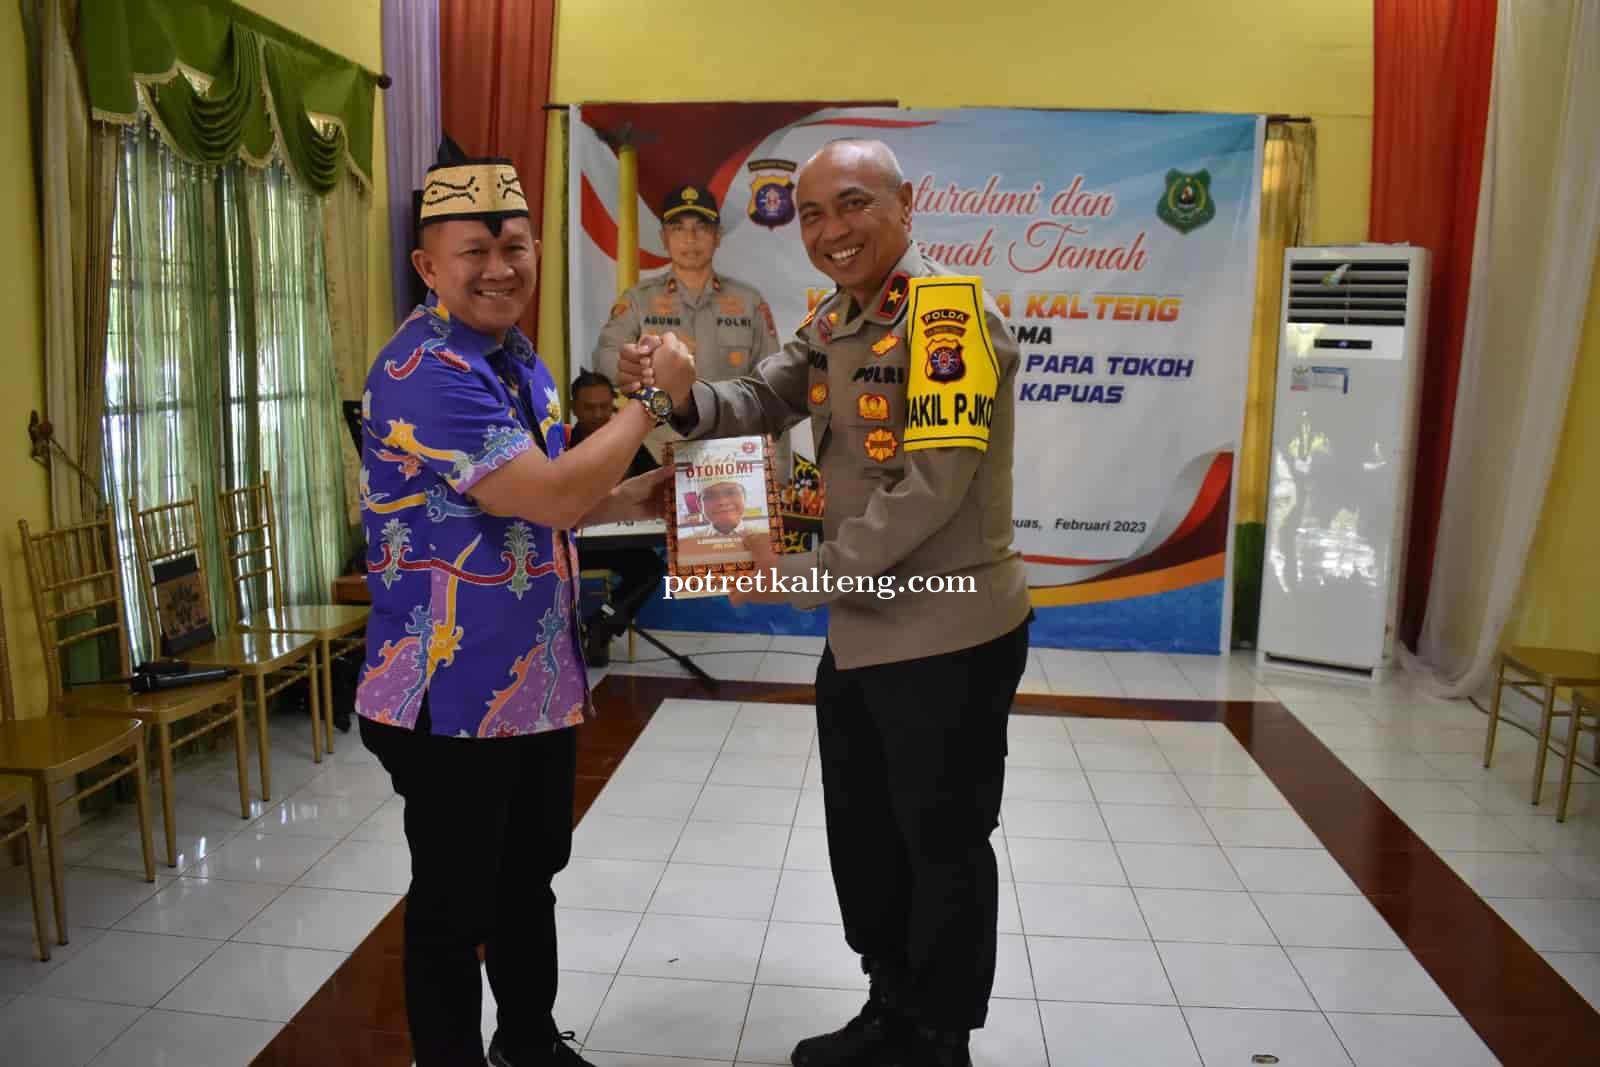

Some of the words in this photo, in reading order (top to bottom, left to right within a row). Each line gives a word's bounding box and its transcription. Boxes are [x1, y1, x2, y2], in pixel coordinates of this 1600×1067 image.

[912, 175, 1042, 215] turahmi
[1051, 175, 1114, 217] dan
[1008, 221, 1149, 273] Tamah
[925, 311, 966, 323] POLDA
[1025, 293, 1182, 322] KALTENG
[644, 315, 681, 326] AGUNG
[716, 317, 752, 328] POLRI
[1009, 326, 1052, 344] MA
[1026, 354, 1094, 375] PARA
[1107, 357, 1194, 378] TOKOH
[1019, 383, 1125, 404] KAPUAS
[686, 461, 752, 478] OTONOMI
[1055, 518, 1111, 532] Februari
[1113, 520, 1147, 533] 2023
